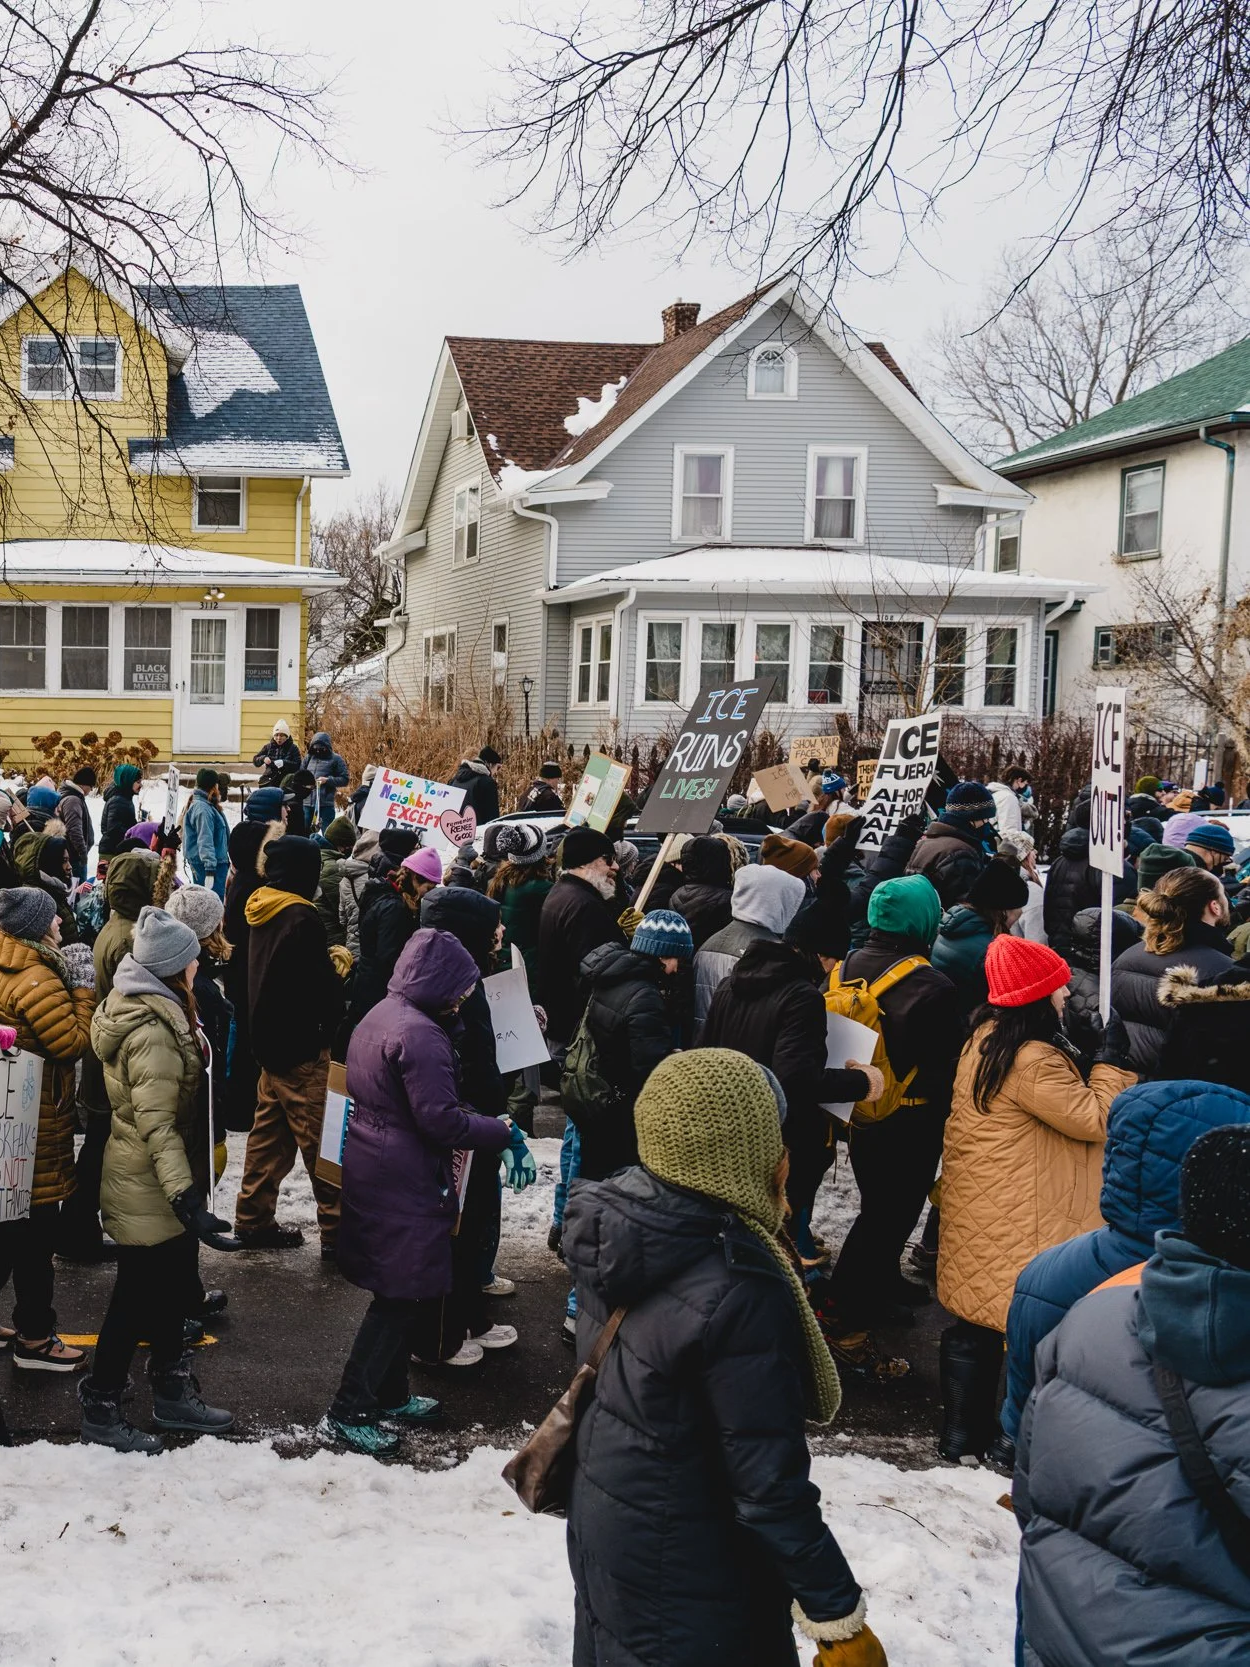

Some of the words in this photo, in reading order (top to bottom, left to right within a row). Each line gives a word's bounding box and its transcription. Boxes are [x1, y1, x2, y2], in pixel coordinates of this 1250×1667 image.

[200, 602, 218, 610] 3112
[135, 664, 166, 672] BLACK
[137, 674, 165, 682] LIVES
[133, 682, 168, 690] MATTER
[696, 688, 759, 723] ICE
[792, 739, 818, 750] SHOW
[882, 721, 940, 760] ICE
[1094, 702, 1122, 774] ICE
[664, 730, 748, 772] RUINS
[796, 749, 822, 758] FACES
[382, 770, 413, 788] Love
[424, 780, 450, 798] Your
[659, 778, 720, 800] LIVES!
[870, 788, 924, 802] AHOR
[386, 802, 442, 828] EXCEPT
[1091, 785, 1122, 852] OUT!
[3, 1158, 28, 1188] NOT
